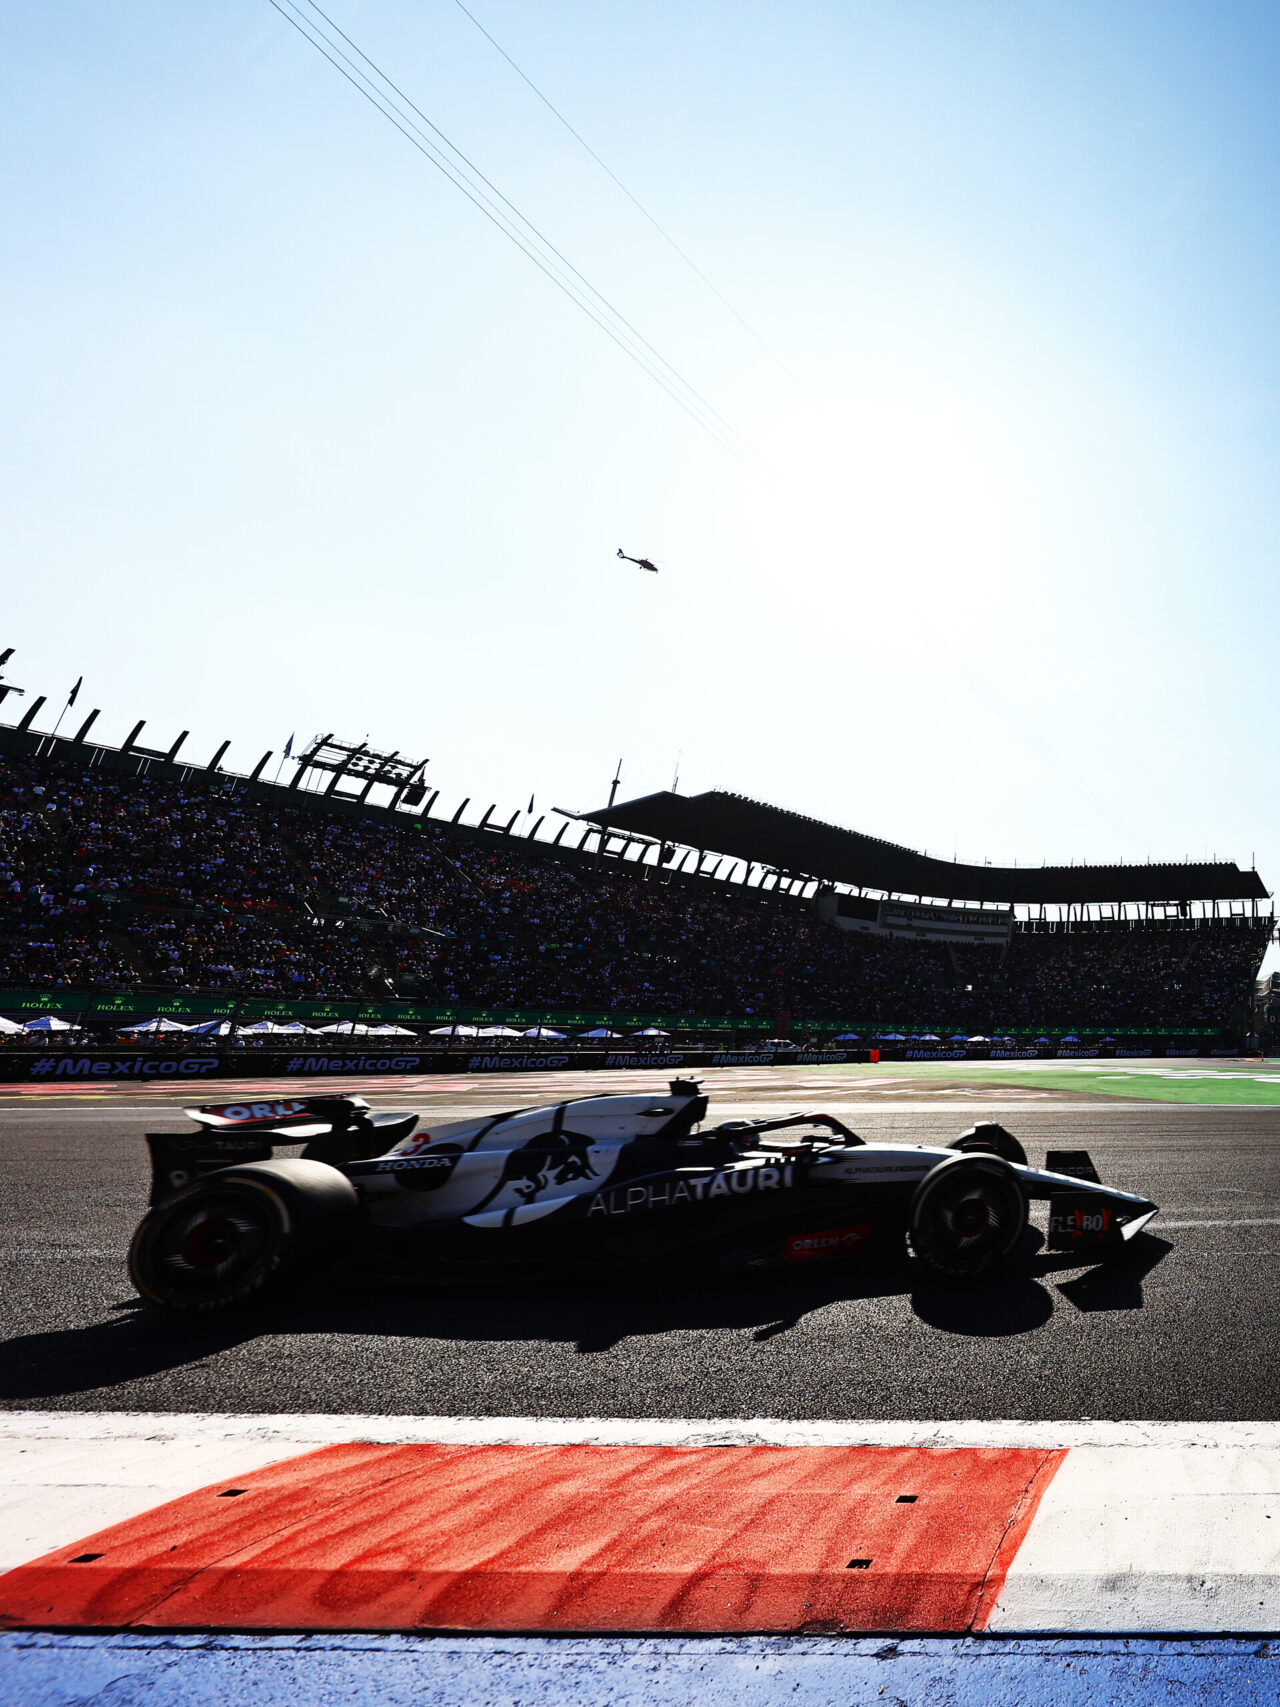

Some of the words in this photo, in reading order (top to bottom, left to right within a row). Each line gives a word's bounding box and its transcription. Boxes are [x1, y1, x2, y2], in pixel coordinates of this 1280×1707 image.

[712, 1053, 774, 1064] #MexicoGP
[796, 1052, 847, 1062] #MexicoGP
[905, 1049, 967, 1059] #MexicoGP
[990, 1049, 1038, 1058] #MexicoGP
[1056, 1049, 1100, 1057] #MexicoGP
[30, 1057, 220, 1076] #MexicoGP
[286, 1056, 421, 1072] #MexicoGP
[467, 1055, 569, 1069] #MexicoGP
[605, 1054, 684, 1066] #MexicoGP
[400, 1133, 430, 1156] 3
[376, 1158, 452, 1171] HONDA
[586, 1165, 795, 1218] ALPHATAURI
[792, 1236, 839, 1250] ORLEN
